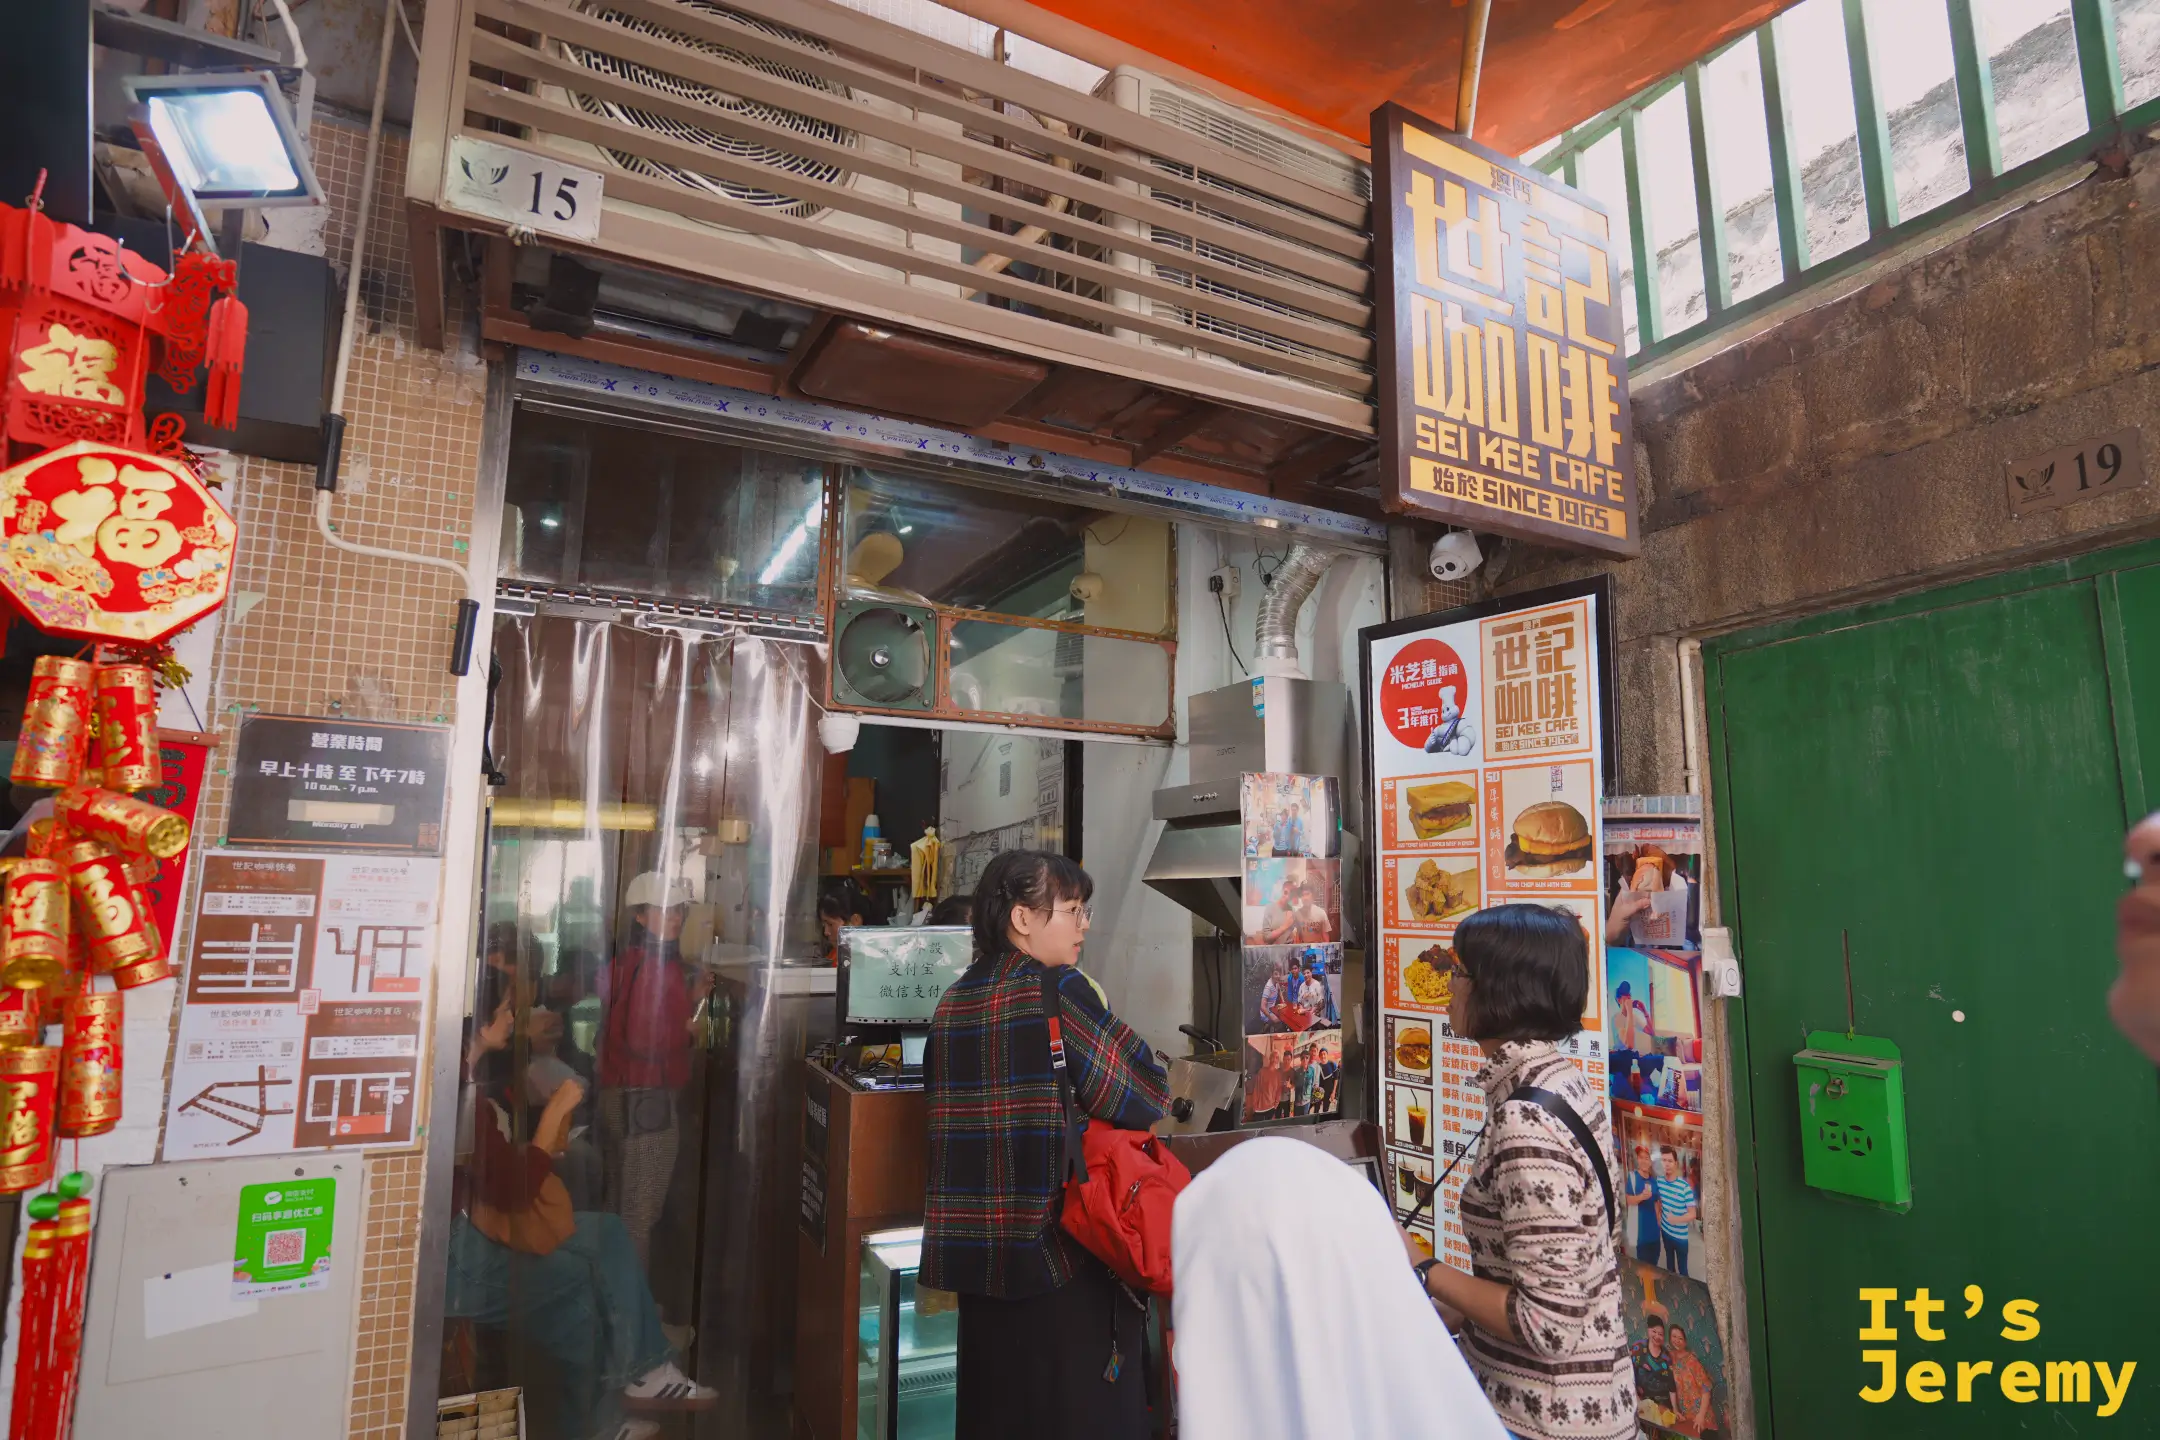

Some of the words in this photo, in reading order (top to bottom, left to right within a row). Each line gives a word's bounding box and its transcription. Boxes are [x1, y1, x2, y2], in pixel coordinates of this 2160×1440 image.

[527, 171, 579, 221] 15
[1405, 168, 1616, 354] 世記
[1411, 292, 1622, 467] 咖啡
[1416, 413, 1468, 462] SEI
[1479, 430, 1540, 481] KEE
[1549, 452, 1625, 503] CAFE
[2073, 443, 2122, 491] 19
[1432, 466, 1478, 500] 始於
[1483, 478, 1552, 520] SINCE
[1558, 497, 1609, 533] 1965
[1493, 627, 1577, 681] 世記
[1494, 673, 1577, 724] 咖啡
[1397, 708, 1409, 729] 3
[1496, 726, 1514, 739] SEI
[1518, 722, 1541, 736] KEE
[1545, 718, 1578, 733] CAFE
[311, 732, 383, 752] 營業時間
[1520, 738, 1546, 750] SINCE
[1548, 734, 1572, 746] 1965
[259, 760, 334, 781] 早上十時
[339, 765, 356, 781] 至
[363, 766, 426, 785] 下午7時
[304, 781, 318, 790] 10
[349, 784, 357, 792] 7
[358, 786, 379, 794] p.m.
[889, 962, 934, 976] 支付宝
[879, 984, 940, 998] 微信支付
[1587, 1060, 1604, 1075] 22
